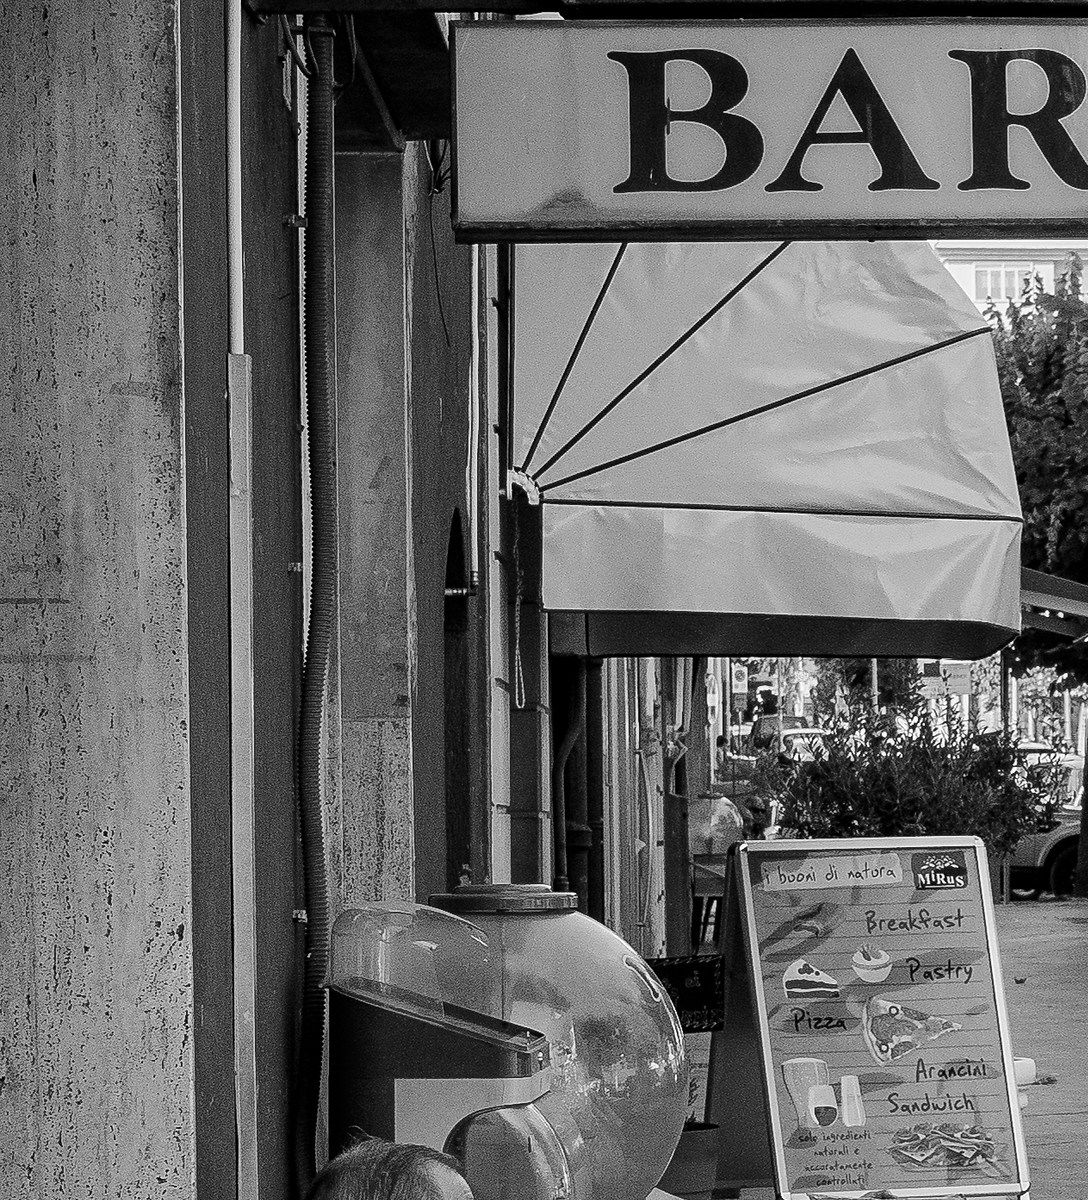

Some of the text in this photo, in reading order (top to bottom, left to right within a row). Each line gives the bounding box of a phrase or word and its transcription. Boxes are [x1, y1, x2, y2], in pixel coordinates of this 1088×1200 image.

[825, 864, 839, 881] di
[849, 861, 896, 880] natura
[865, 908, 964, 934] Breakfast
[906, 957, 973, 984] Pastry
[790, 1008, 847, 1031] Pizza
[915, 1058, 988, 1082] Arancini
[887, 1092, 975, 1113] Sandwich
[798, 1129, 871, 1143] solo ingredienti
[816, 1174, 866, 1186] controllati
